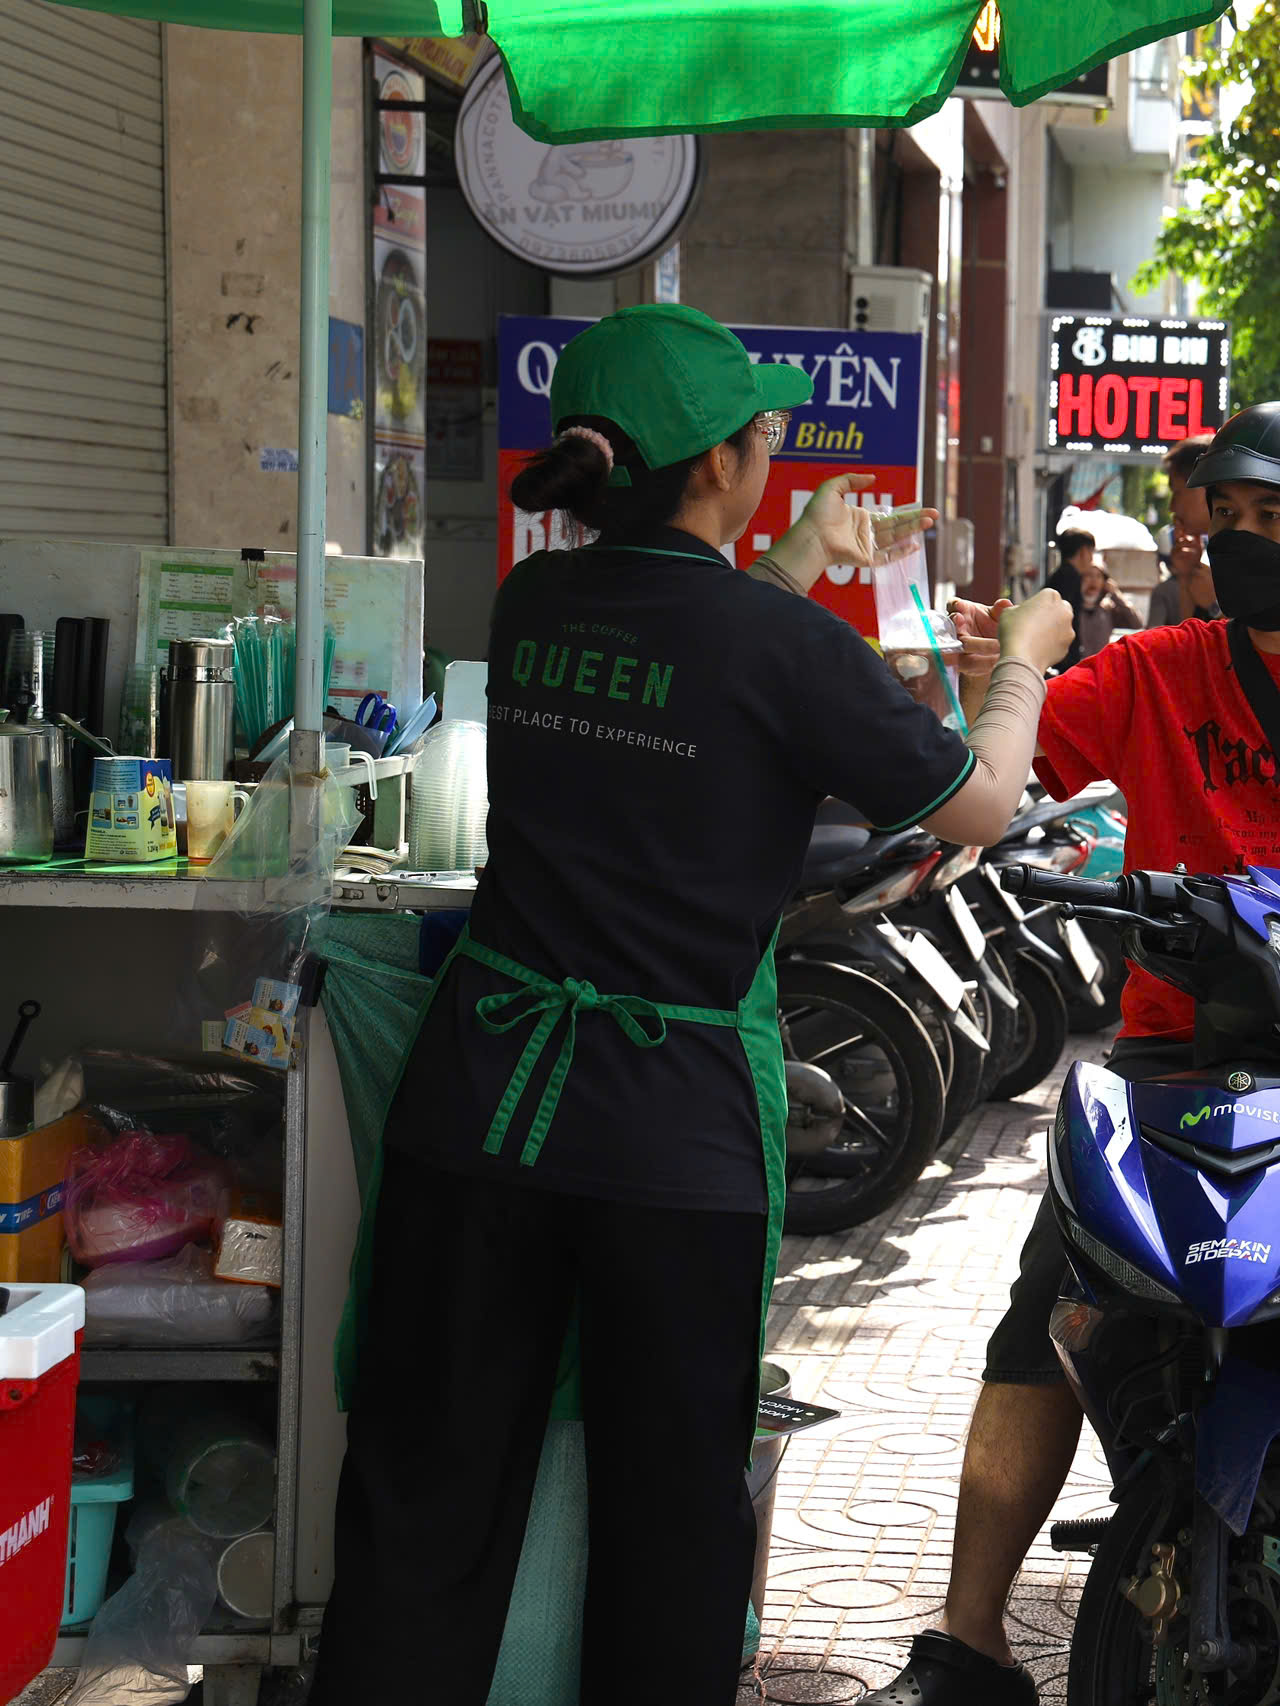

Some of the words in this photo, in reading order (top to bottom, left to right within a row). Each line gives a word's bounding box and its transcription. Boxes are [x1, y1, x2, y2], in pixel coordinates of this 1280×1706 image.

[482, 89, 511, 203] PANNACOTT
[1112, 334, 1157, 363] BIN
[1163, 336, 1208, 365] BIN
[1058, 373, 1217, 440] HOTEL
[795, 421, 864, 451] Bình
[562, 623, 585, 633] THE
[512, 639, 675, 708] QUEEN
[513, 708, 563, 731] PLACE
[570, 718, 590, 735] TO
[596, 725, 697, 758] EXPERIENCE
[1204, 1248, 1268, 1264] DEPAN
